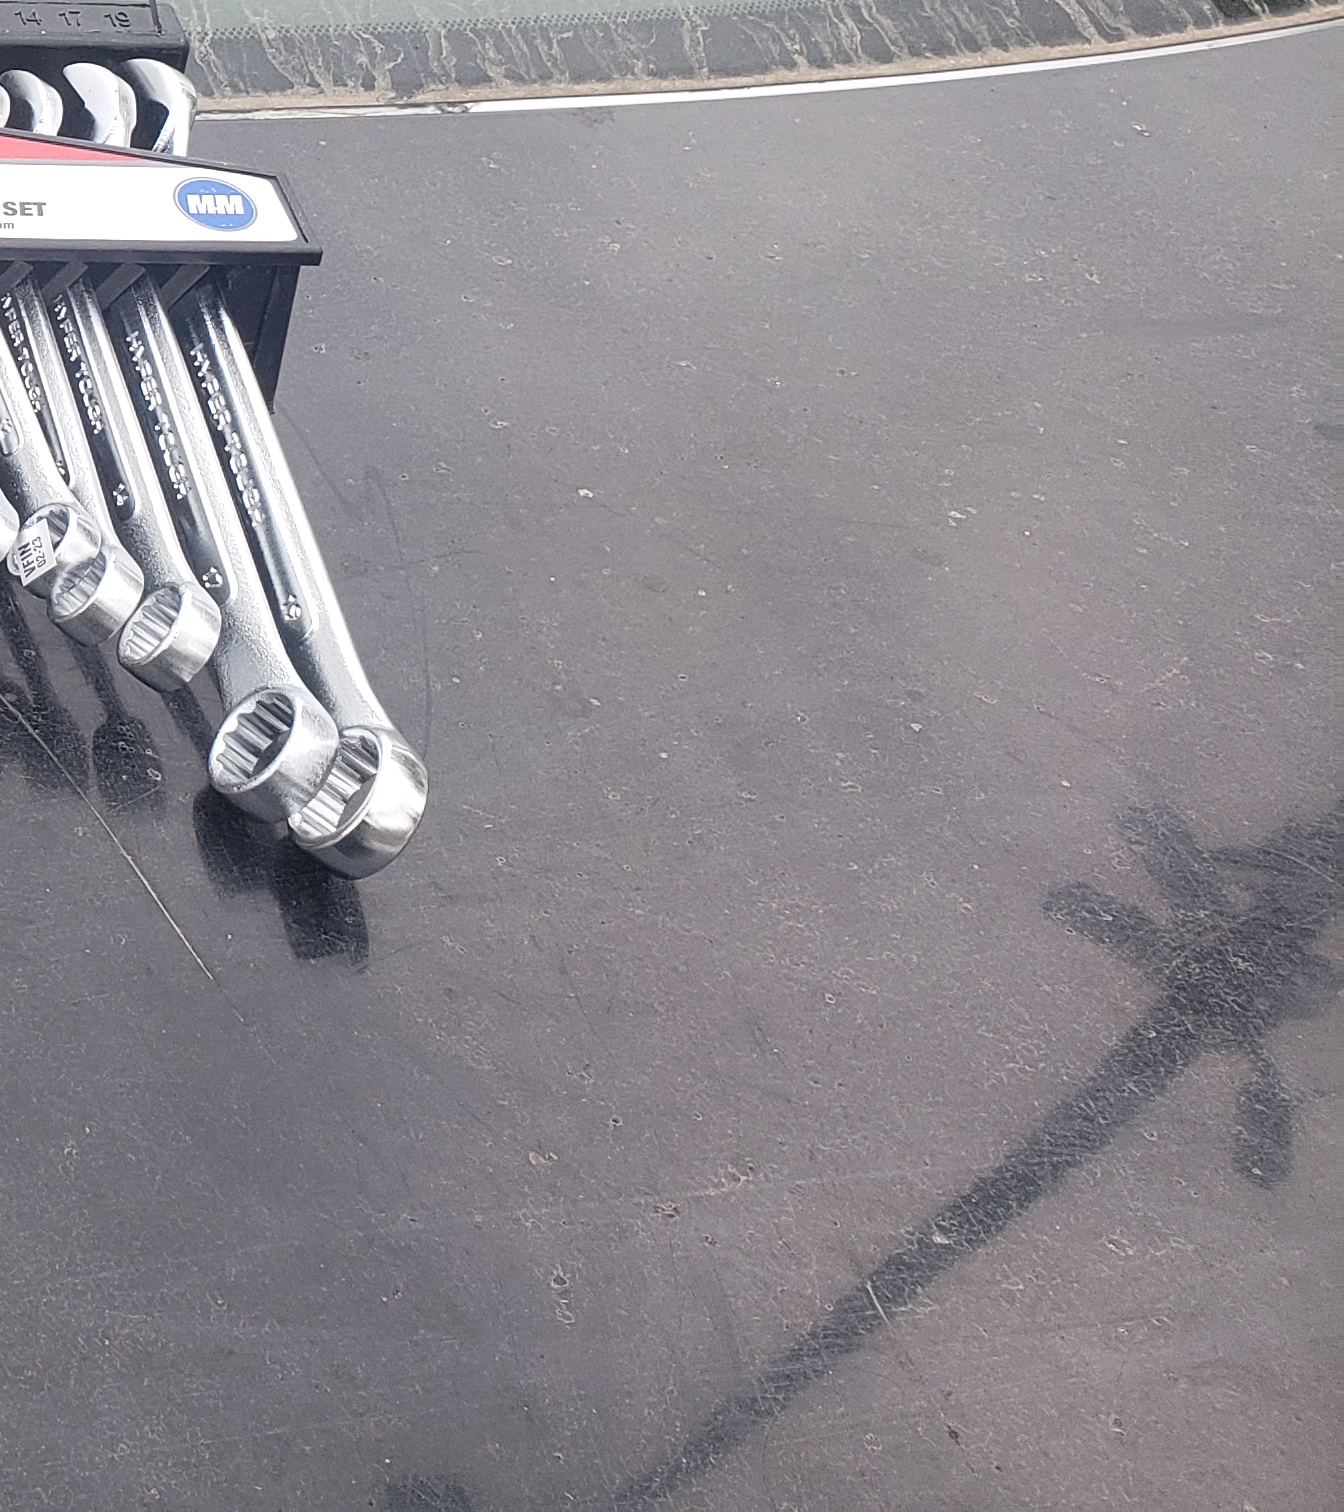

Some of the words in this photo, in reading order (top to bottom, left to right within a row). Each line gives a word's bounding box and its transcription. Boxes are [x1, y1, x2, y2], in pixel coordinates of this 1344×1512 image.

[14, 9, 43, 26] 14
[59, 10, 81, 27] 17
[104, 11, 131, 28] 19
[2, 201, 47, 217] SET
[185, 194, 245, 215] MM
[125, 330, 162, 412] HYPER
[155, 412, 193, 500] TOUGH
[189, 342, 233, 431] HYPER
[224, 431, 266, 528] TOUGH
[18, 541, 36, 578] VFIN
[32, 536, 47, 568] 02-23
